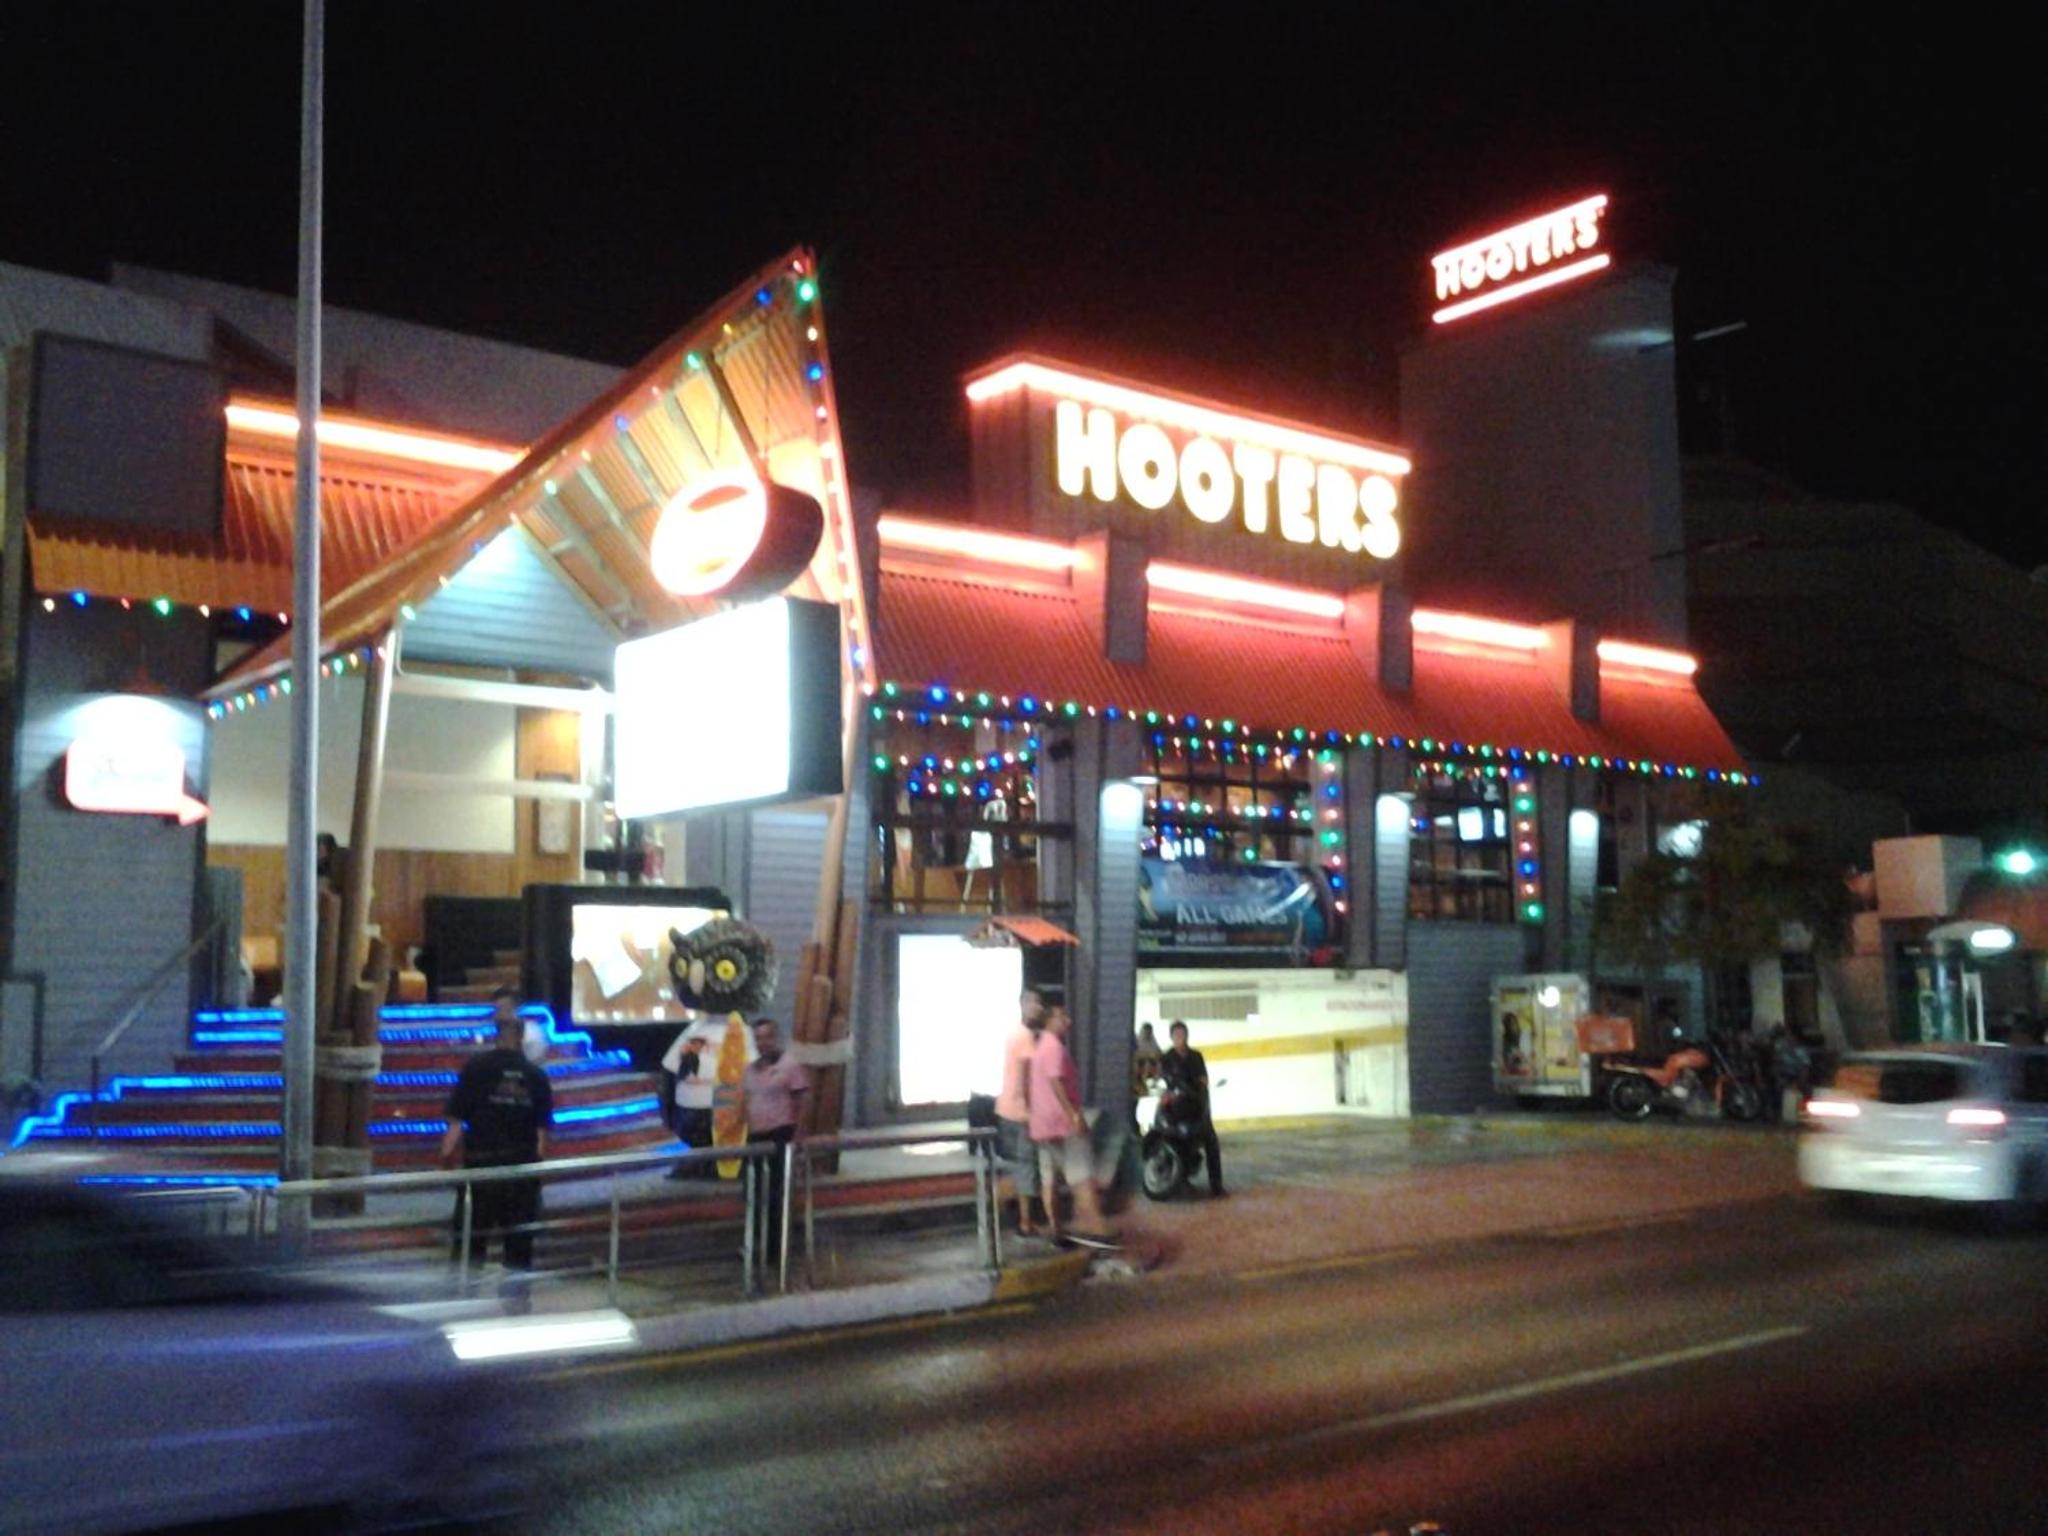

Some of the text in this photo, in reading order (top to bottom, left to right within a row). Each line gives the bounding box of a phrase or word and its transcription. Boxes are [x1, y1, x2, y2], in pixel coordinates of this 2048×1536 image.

[1433, 203, 1599, 300] HOOTERS
[1056, 400, 1400, 559] HOOTERS
[1177, 903, 1217, 924] ALL
